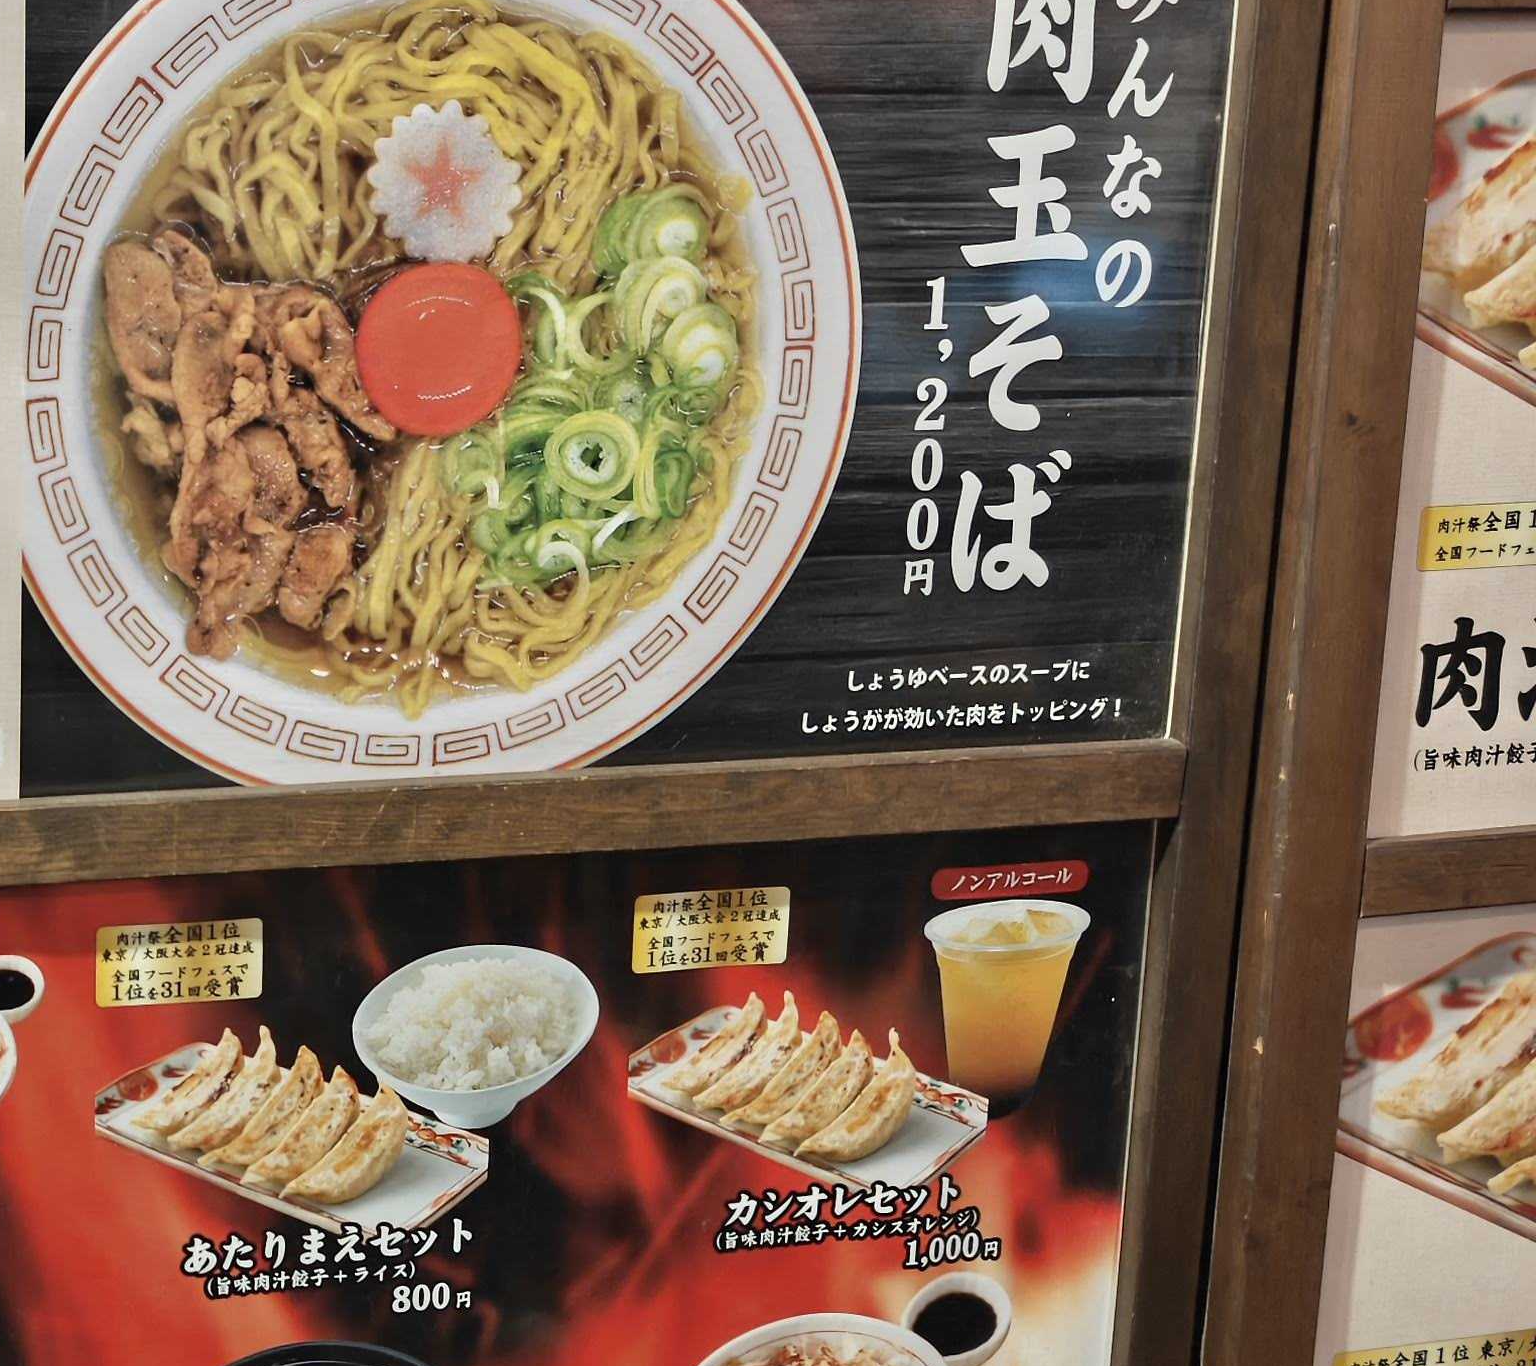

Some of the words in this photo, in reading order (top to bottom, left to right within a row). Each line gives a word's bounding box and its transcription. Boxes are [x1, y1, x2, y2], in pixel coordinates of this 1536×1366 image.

[903, 277, 948, 597] 1,200円
[847, 660, 1091, 693] しょうゆベースのスープに
[801, 698, 1123, 735] しょうがが効いた肉をトッピング！
[951, 867, 1073, 892] ノンアルコール
[653, 890, 768, 913] 肉汁祭全国1位
[117, 923, 240, 945] 肉汁祭全国1位
[648, 931, 775, 950] 全国フードフェスで
[647, 942, 769, 967] 1位を31回受賞
[112, 964, 248, 982] 全国フードフェスで
[112, 976, 243, 1001] 1位を31回受賞
[726, 1177, 958, 1227] カシオレセット
[716, 1210, 978, 1250] （旨味肉汁餃子＋カシスオレンジ）
[184, 1219, 473, 1274] あたりまえセット
[906, 1233, 998, 1266] 1,000円
[207, 1261, 415, 1297] （旨味肉汁餃子＋ライス）
[392, 1283, 472, 1313] 800円
